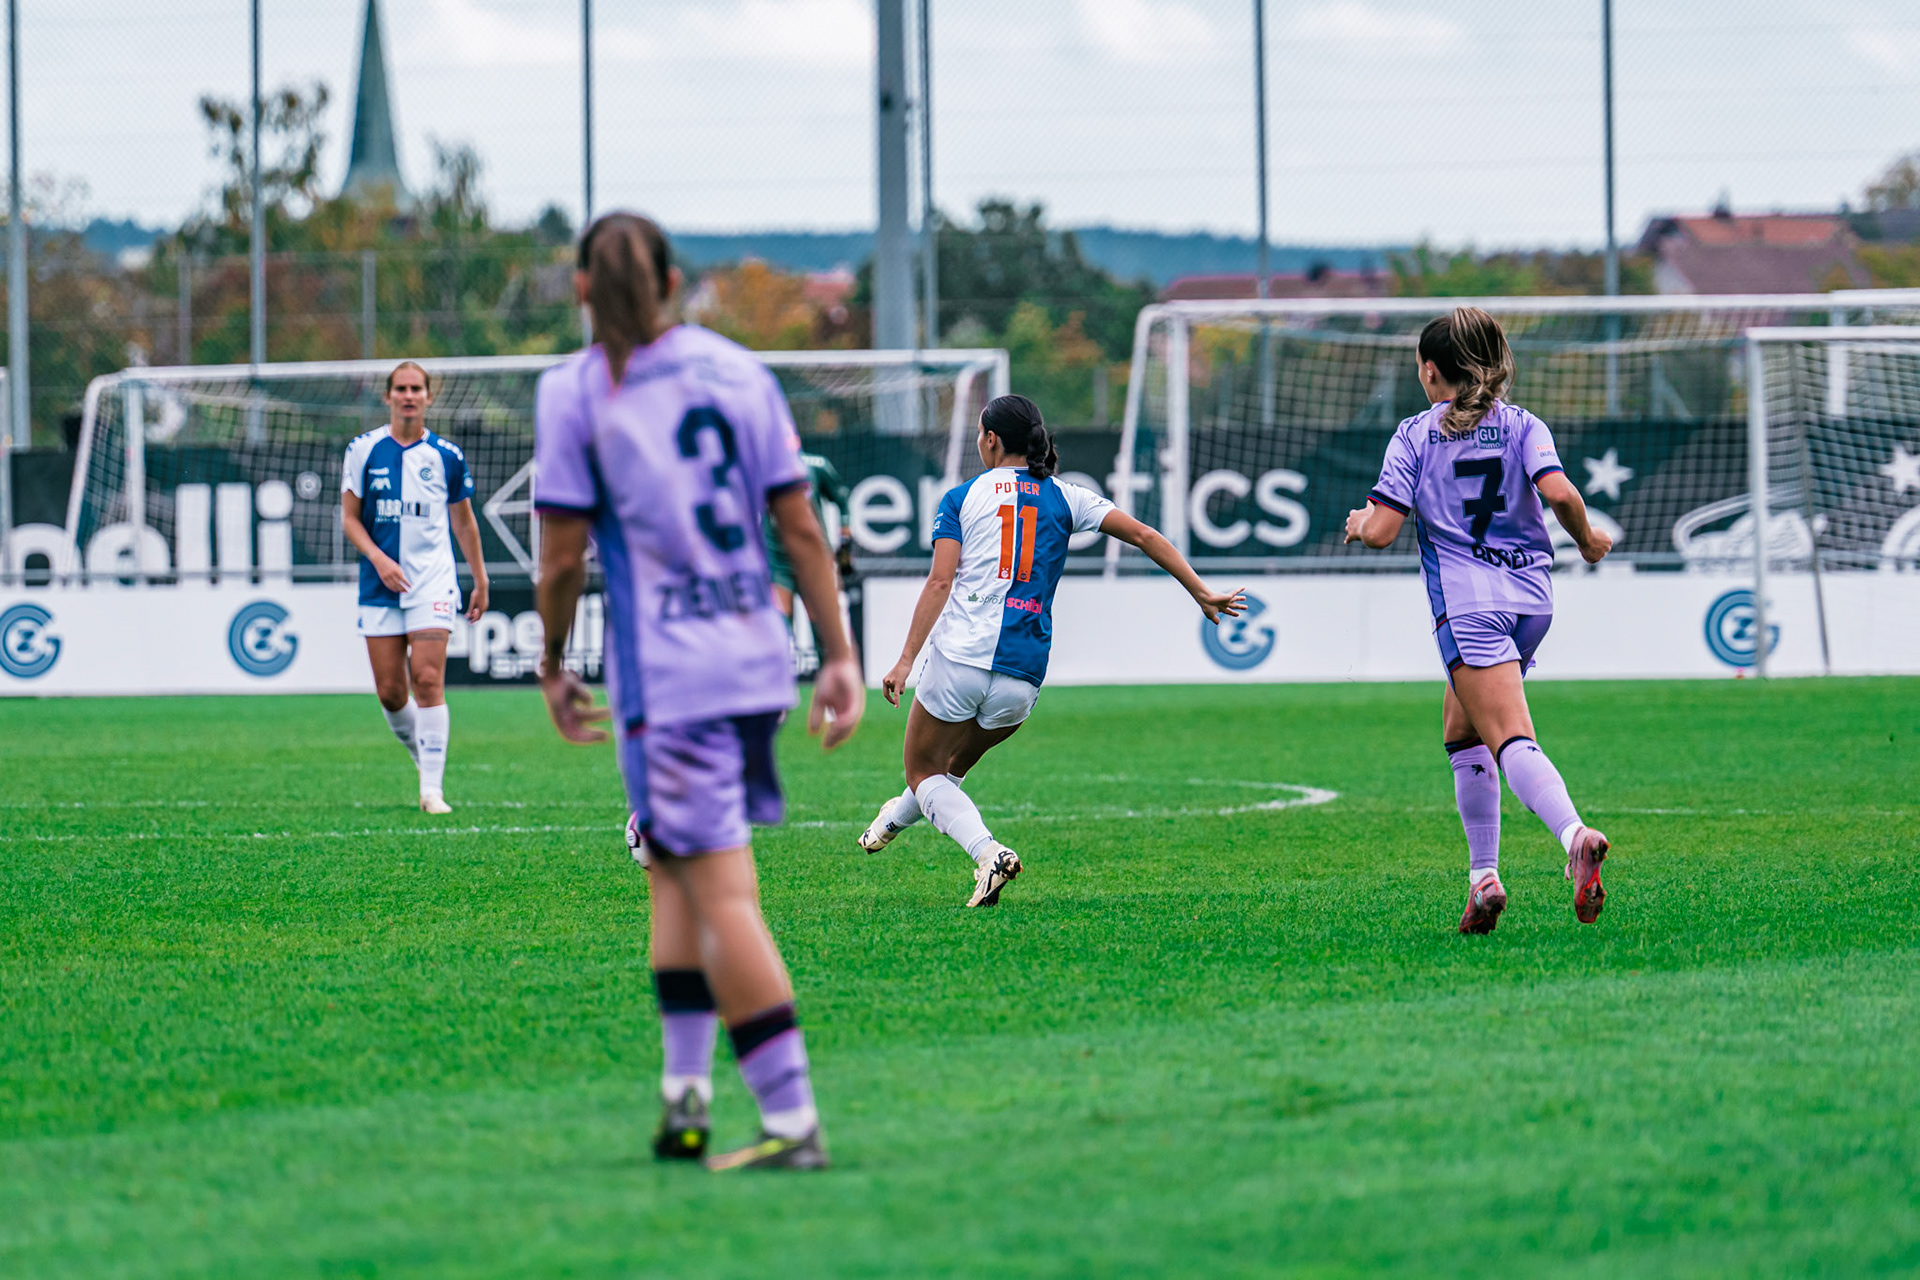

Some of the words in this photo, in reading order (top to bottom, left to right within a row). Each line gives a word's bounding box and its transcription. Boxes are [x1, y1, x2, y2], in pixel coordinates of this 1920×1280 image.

[1480, 427, 1498, 442] GU
[677, 406, 745, 552] 3
[995, 481, 1040, 496] POTIER
[1452, 457, 1508, 546] 7
[996, 504, 1038, 582] 11
